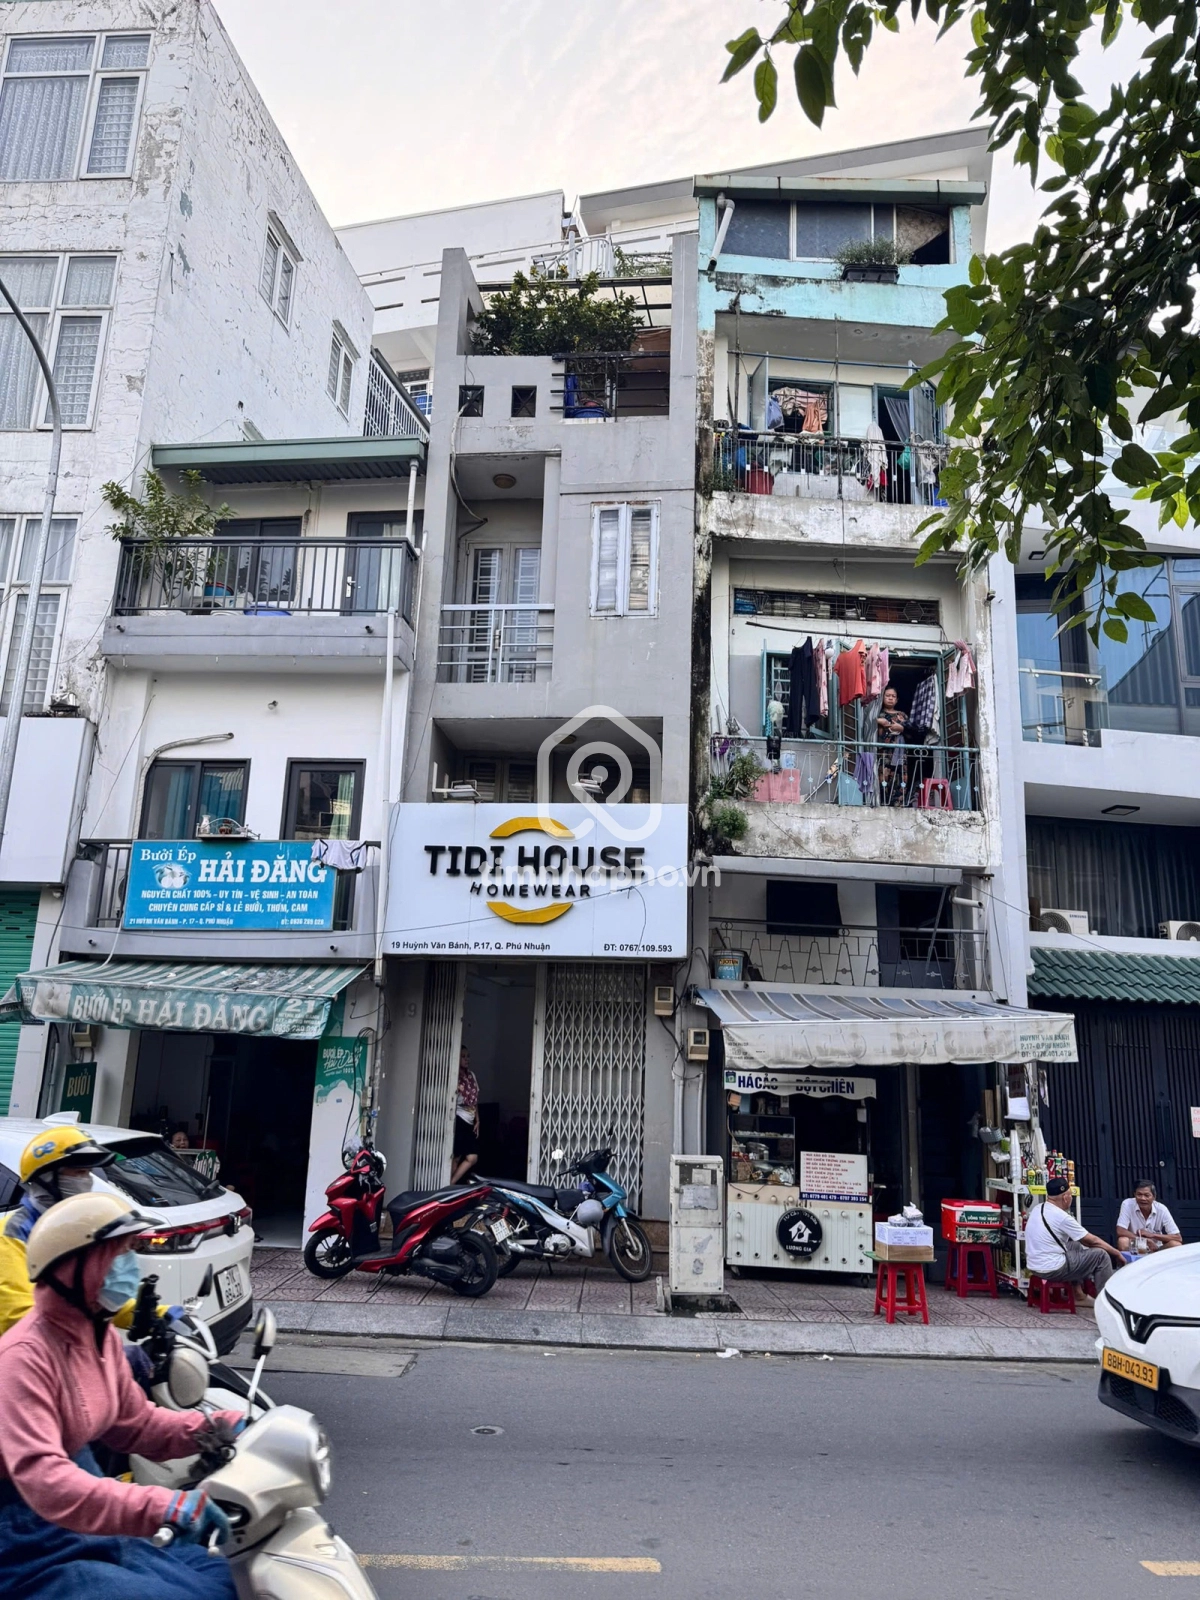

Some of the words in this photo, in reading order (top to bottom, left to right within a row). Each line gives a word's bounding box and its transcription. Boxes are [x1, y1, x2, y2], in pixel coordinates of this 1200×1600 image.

[141, 848, 173, 861] Bưởi
[177, 846, 196, 864] Ép
[424, 845, 505, 876] TIDI
[517, 844, 645, 877] HOUSE
[198, 851, 246, 883] HẢI
[251, 855, 327, 883] ĐĂNG
[142, 889, 170, 899] NGUYÊN
[173, 888, 191, 899] CHẤT
[194, 890, 211, 898] 100%
[219, 890, 229, 899] UY
[232, 889, 243, 899] TÍN
[250, 889, 260, 900] VỆ
[262, 890, 279, 899] SINH
[286, 890, 297, 899] AN
[470, 882, 591, 897] HOMEWEAR
[148, 902, 178, 912] CHUYÊN
[180, 904, 198, 912] CUNG
[200, 901, 215, 912] CẤP
[225, 904, 231, 912] &
[291, 904, 308, 912] CAM
[402, 941, 429, 951] Huỳnh
[506, 942, 521, 950] Phú
[524, 943, 551, 952] Nhuận
[619, 944, 673, 952] 0767.109.593
[72, 988, 110, 1022] BƯỞI
[111, 993, 132, 1024] ÉP
[135, 991, 187, 1028] HẢI
[193, 996, 268, 1032] ĐĂNG
[285, 998, 315, 1013] 21
[1107, 1353, 1153, 1383] 88H-043.93
